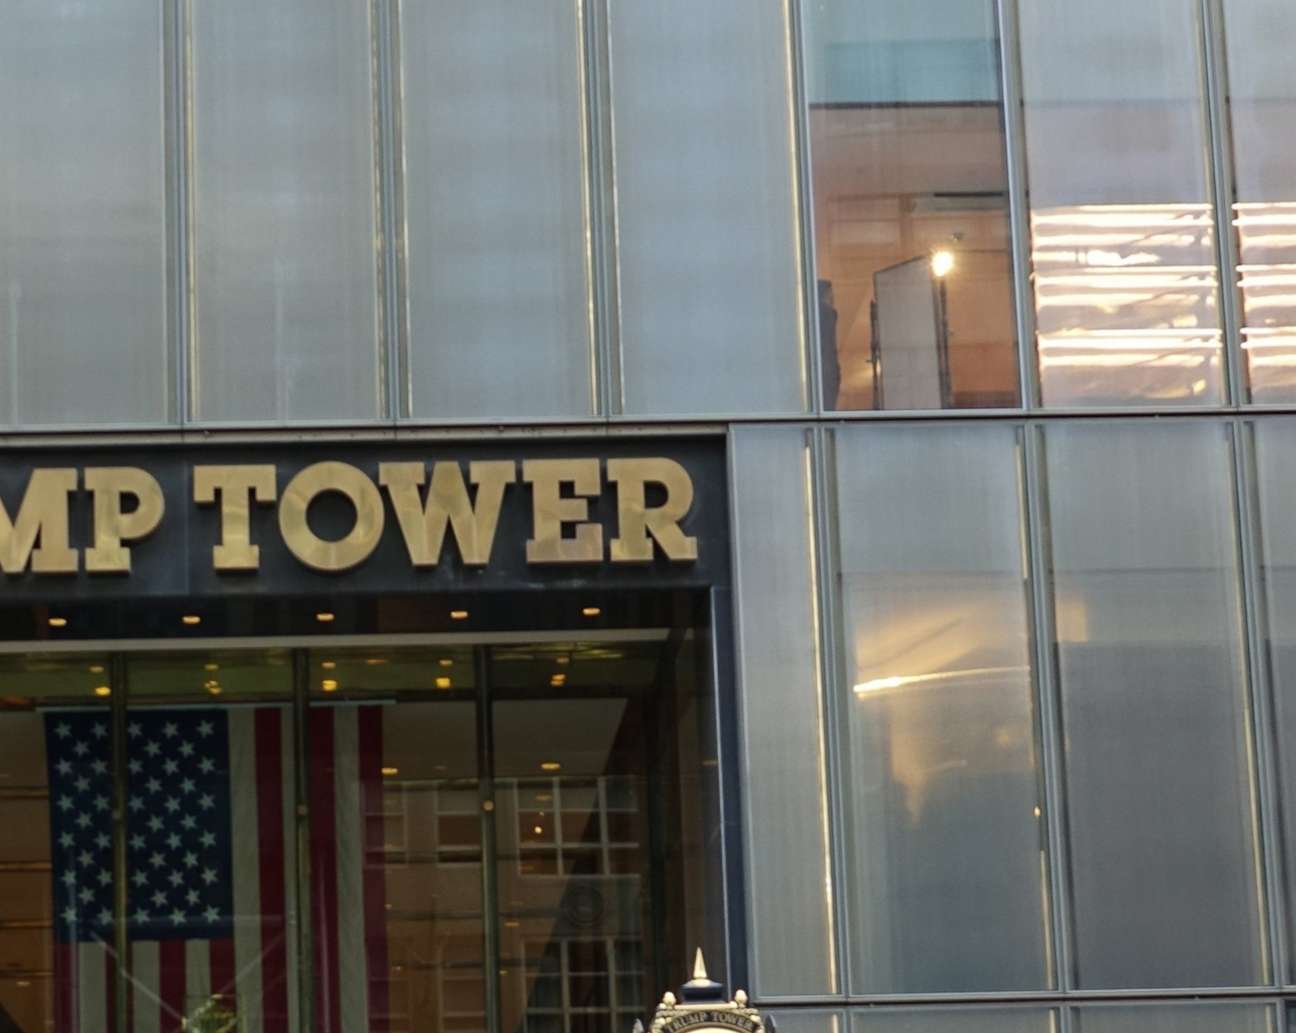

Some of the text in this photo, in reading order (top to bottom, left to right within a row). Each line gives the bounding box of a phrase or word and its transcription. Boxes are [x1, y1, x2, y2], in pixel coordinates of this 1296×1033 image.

[193, 456, 698, 573] TOWER
[667, 1010, 754, 1033] TRUMP TOWER
